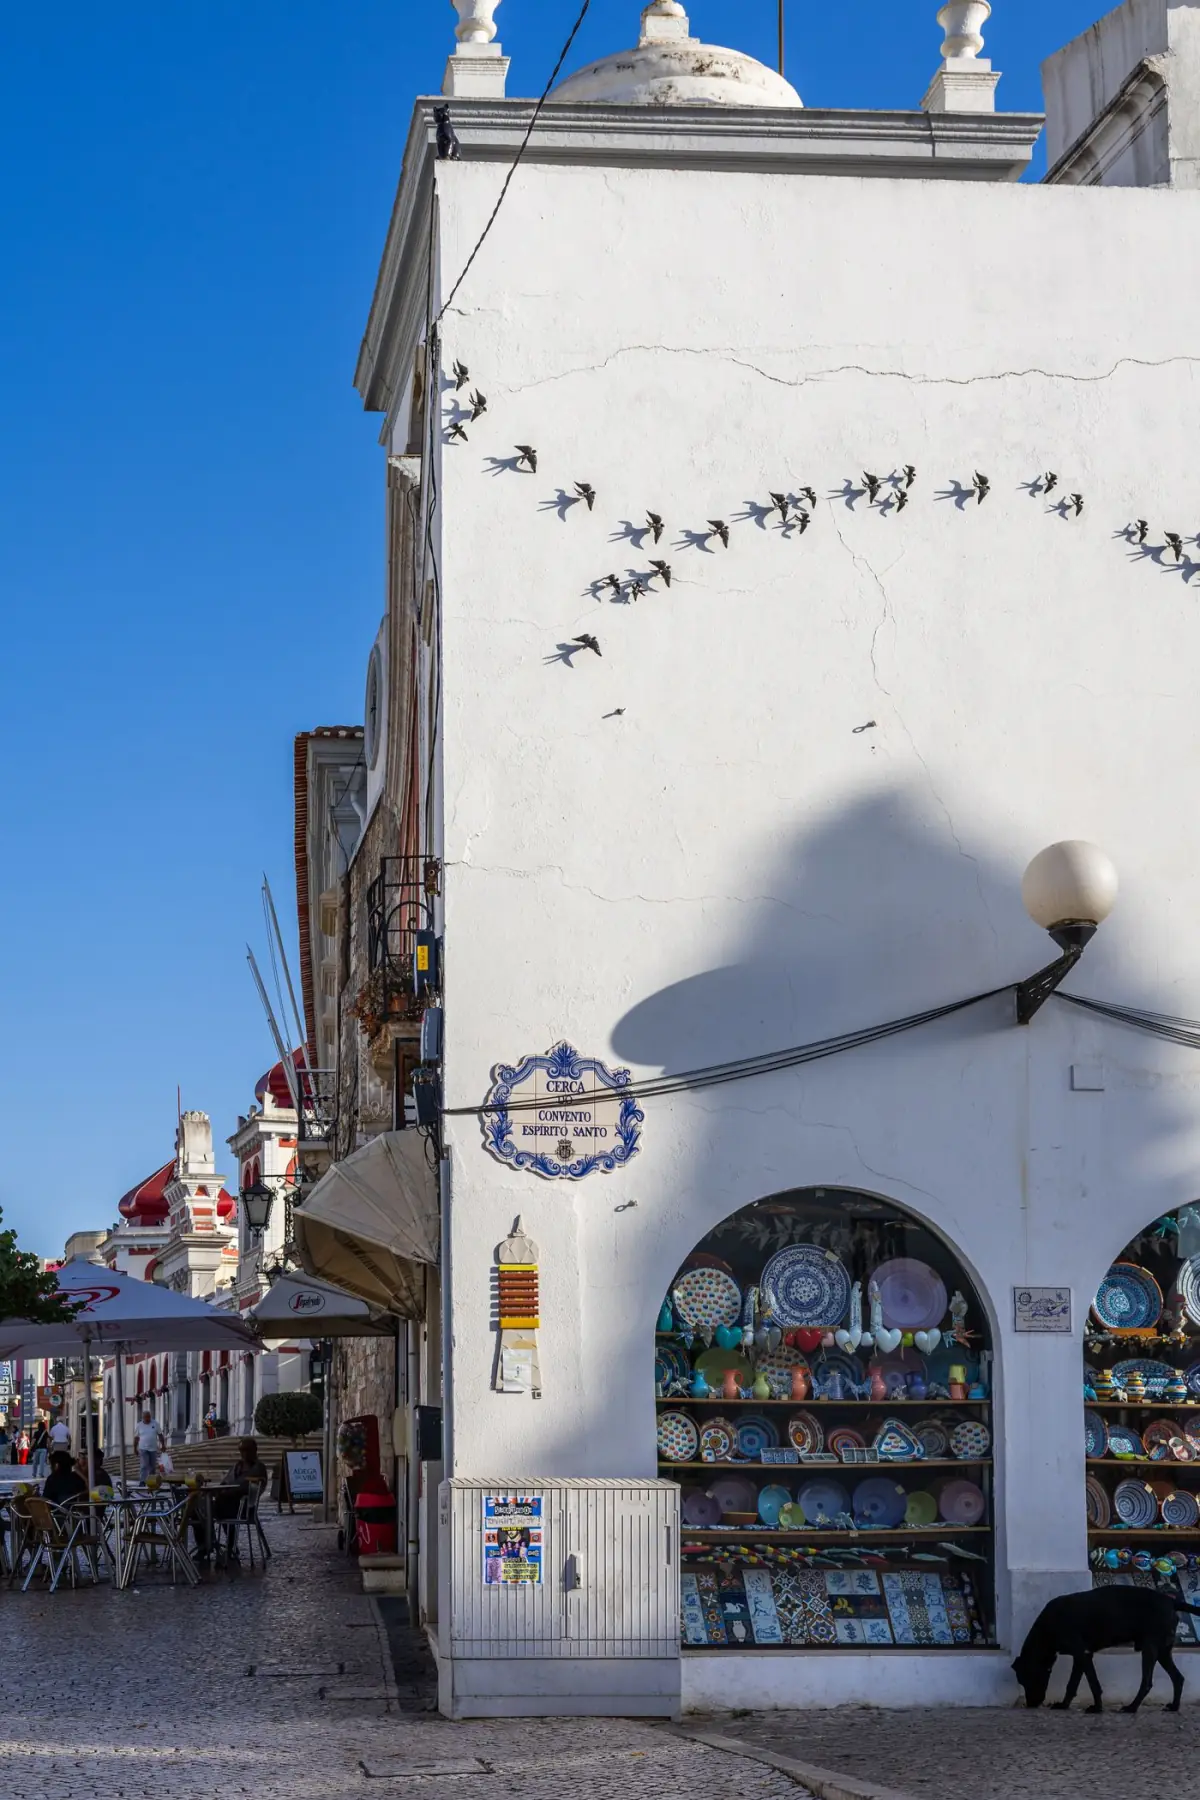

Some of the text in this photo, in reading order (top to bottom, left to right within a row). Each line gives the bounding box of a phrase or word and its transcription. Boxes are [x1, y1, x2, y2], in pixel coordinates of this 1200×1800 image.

[546, 1081, 586, 1093] CERCA
[558, 1095, 573, 1105] DO
[538, 1110, 592, 1123] CONVENTO
[522, 1124, 607, 1138] ESPÍRITO SANTO
